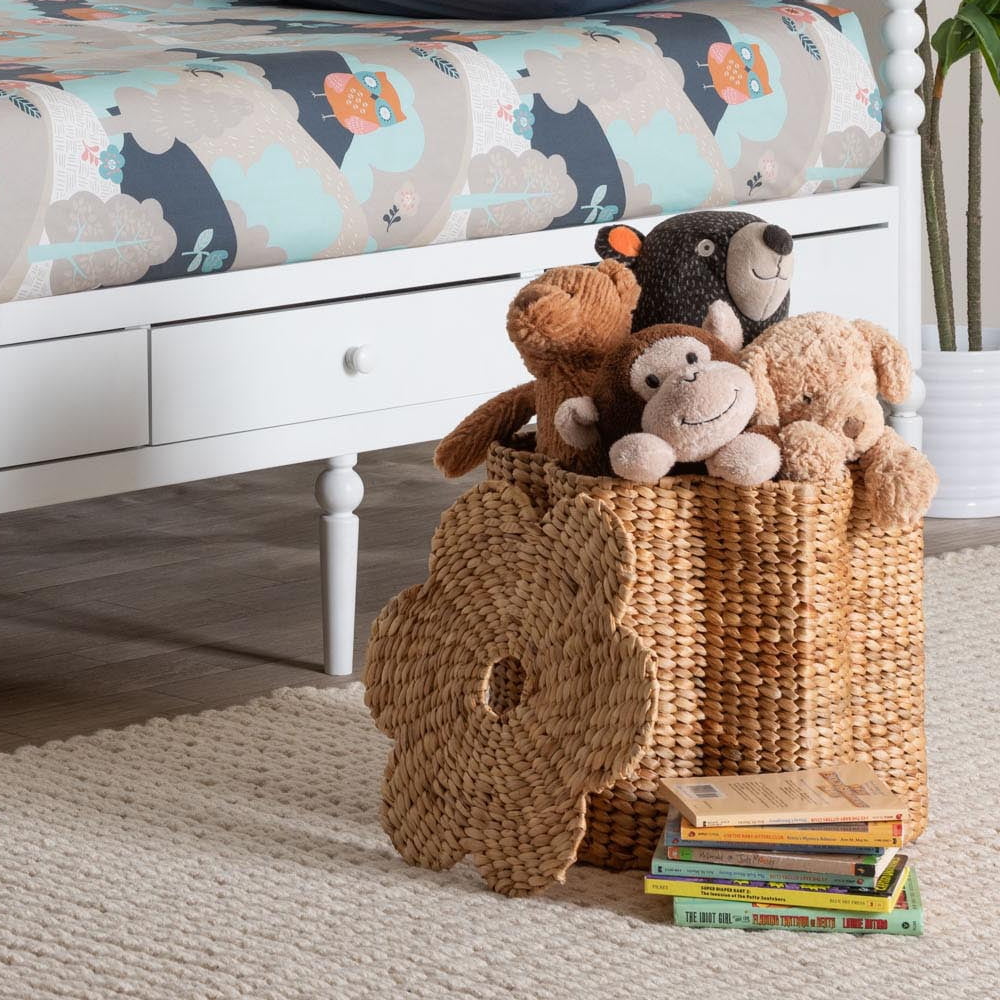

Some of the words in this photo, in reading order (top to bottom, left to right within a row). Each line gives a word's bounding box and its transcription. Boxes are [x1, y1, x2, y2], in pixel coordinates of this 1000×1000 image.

[685, 911, 697, 923] THE
[699, 912, 716, 924] IDIOT
[718, 912, 733, 925] GIRL
